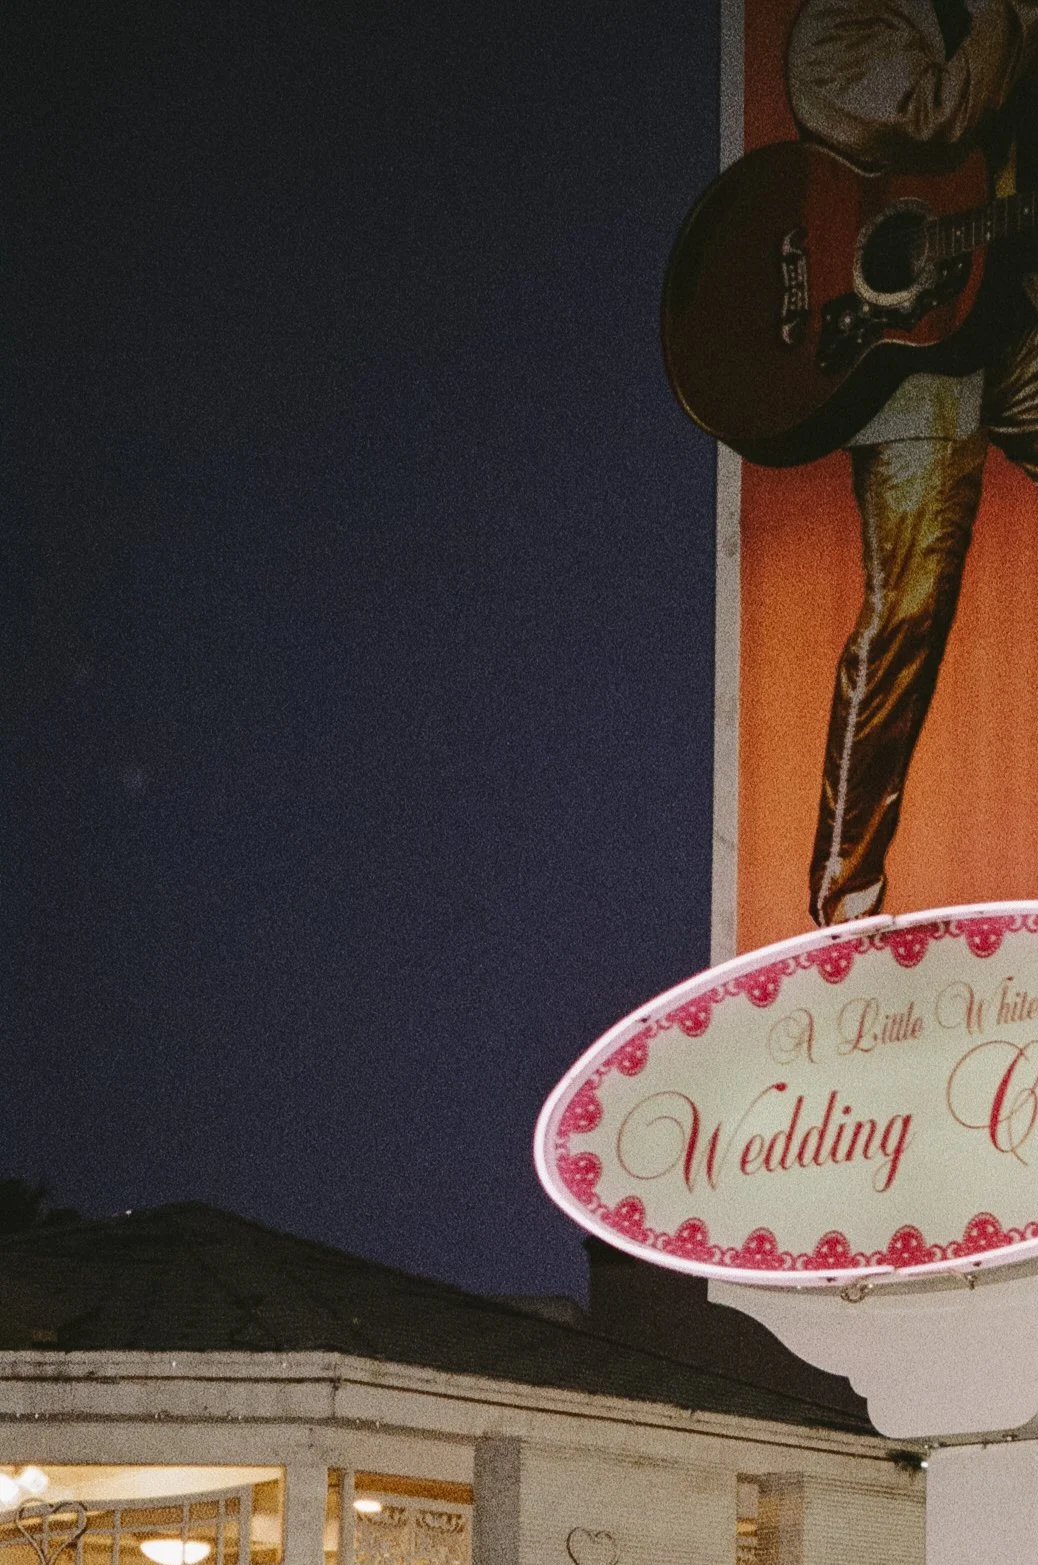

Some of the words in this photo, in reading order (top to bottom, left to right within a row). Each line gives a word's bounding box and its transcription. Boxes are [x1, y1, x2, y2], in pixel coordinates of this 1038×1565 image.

[769, 1007, 818, 1066] A
[837, 997, 924, 1056] Little
[616, 1082, 914, 1194] Wedding
